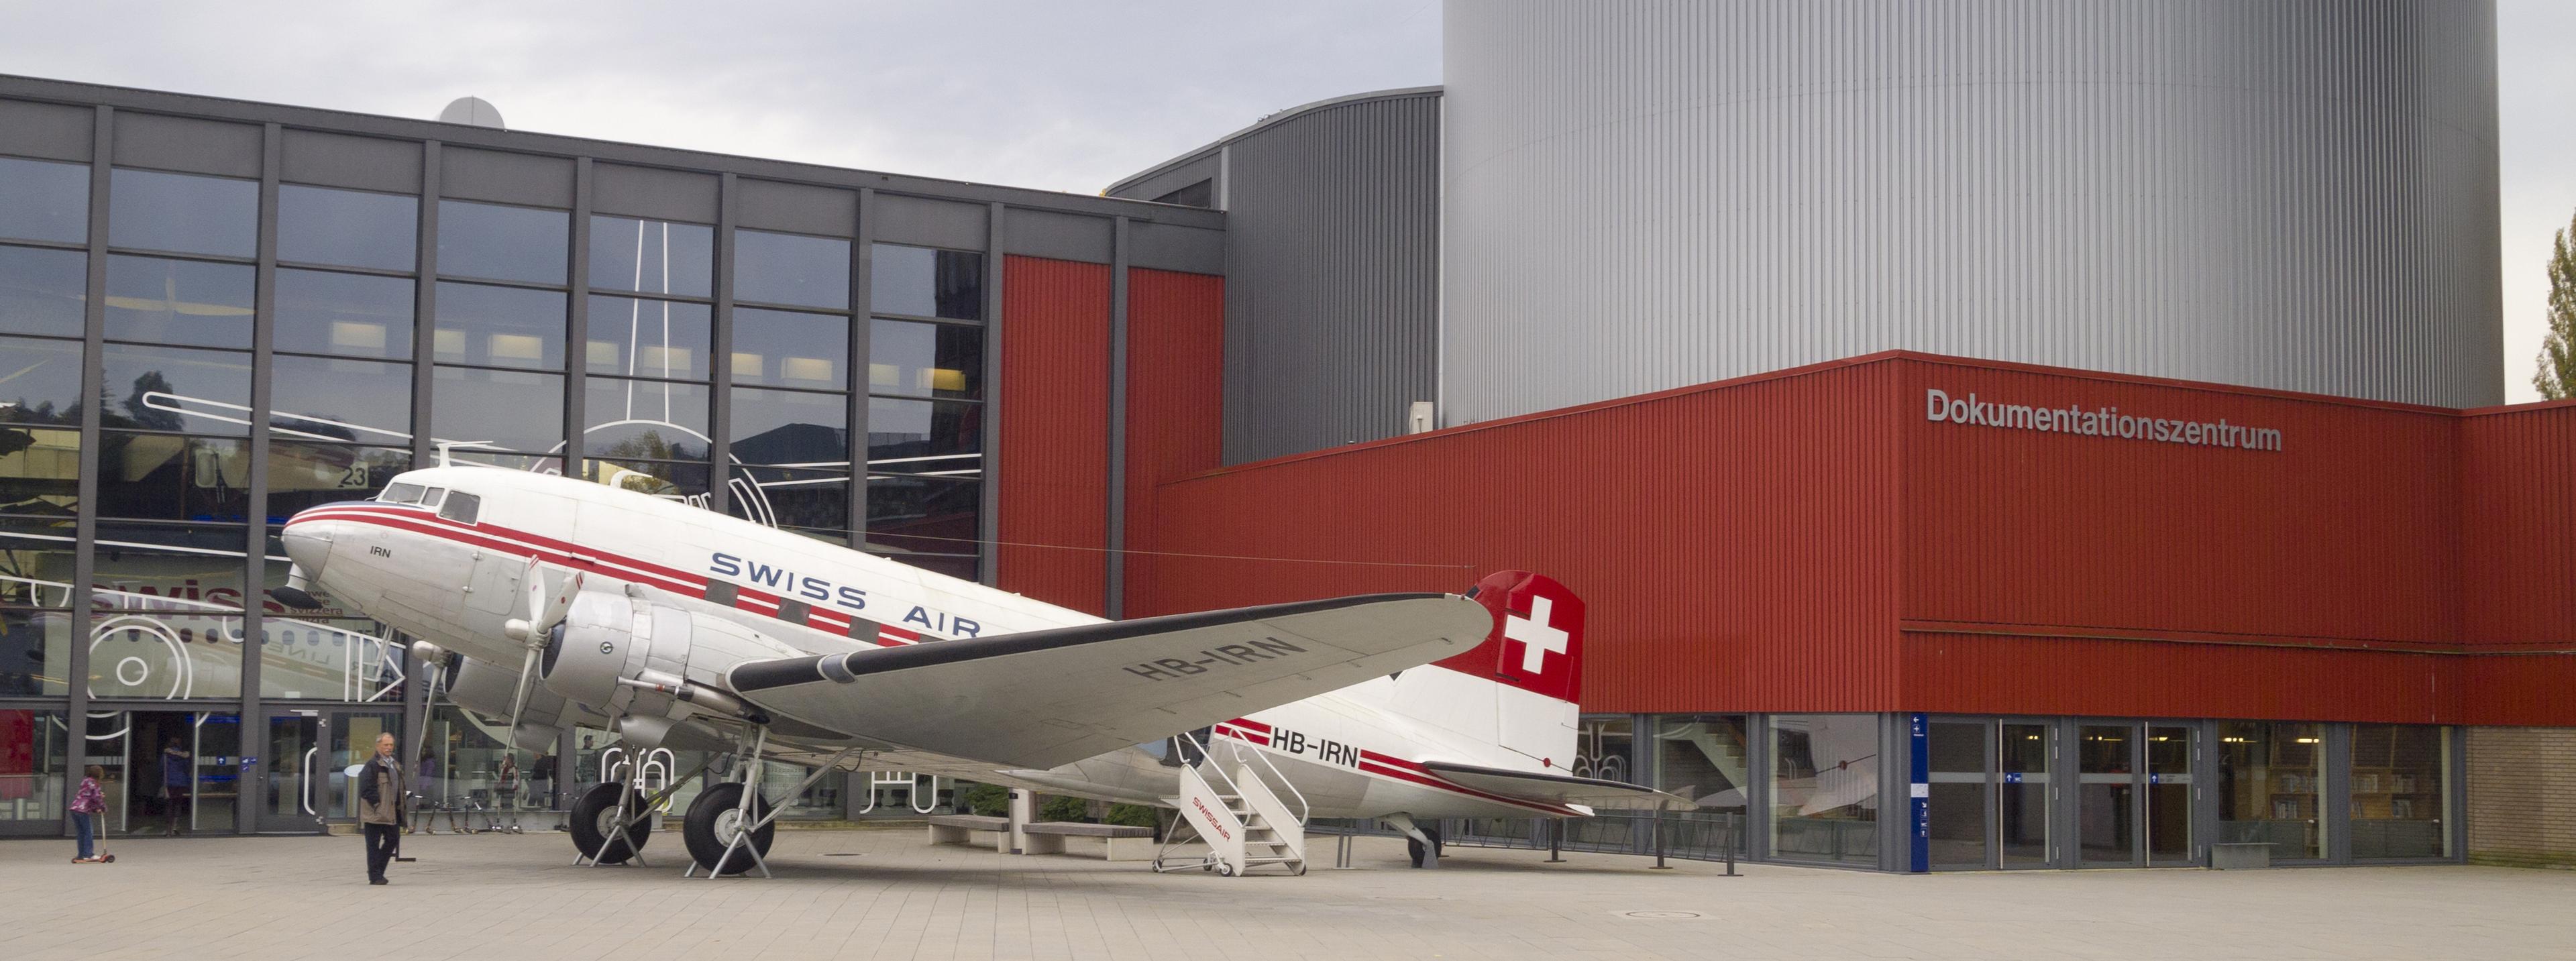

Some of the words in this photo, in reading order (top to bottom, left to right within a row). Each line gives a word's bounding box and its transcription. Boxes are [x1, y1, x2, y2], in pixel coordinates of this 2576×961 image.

[1927, 388, 2281, 451] Dokumentationszentrum
[340, 467, 366, 486] 23
[370, 545, 391, 558] IRN
[710, 552, 867, 610] SWISS
[903, 606, 981, 638] AIR
[1122, 636, 1308, 681] HB-IRN
[1273, 727, 1358, 769] HB-IRN
[1192, 797, 1231, 842] SWISSAIR
